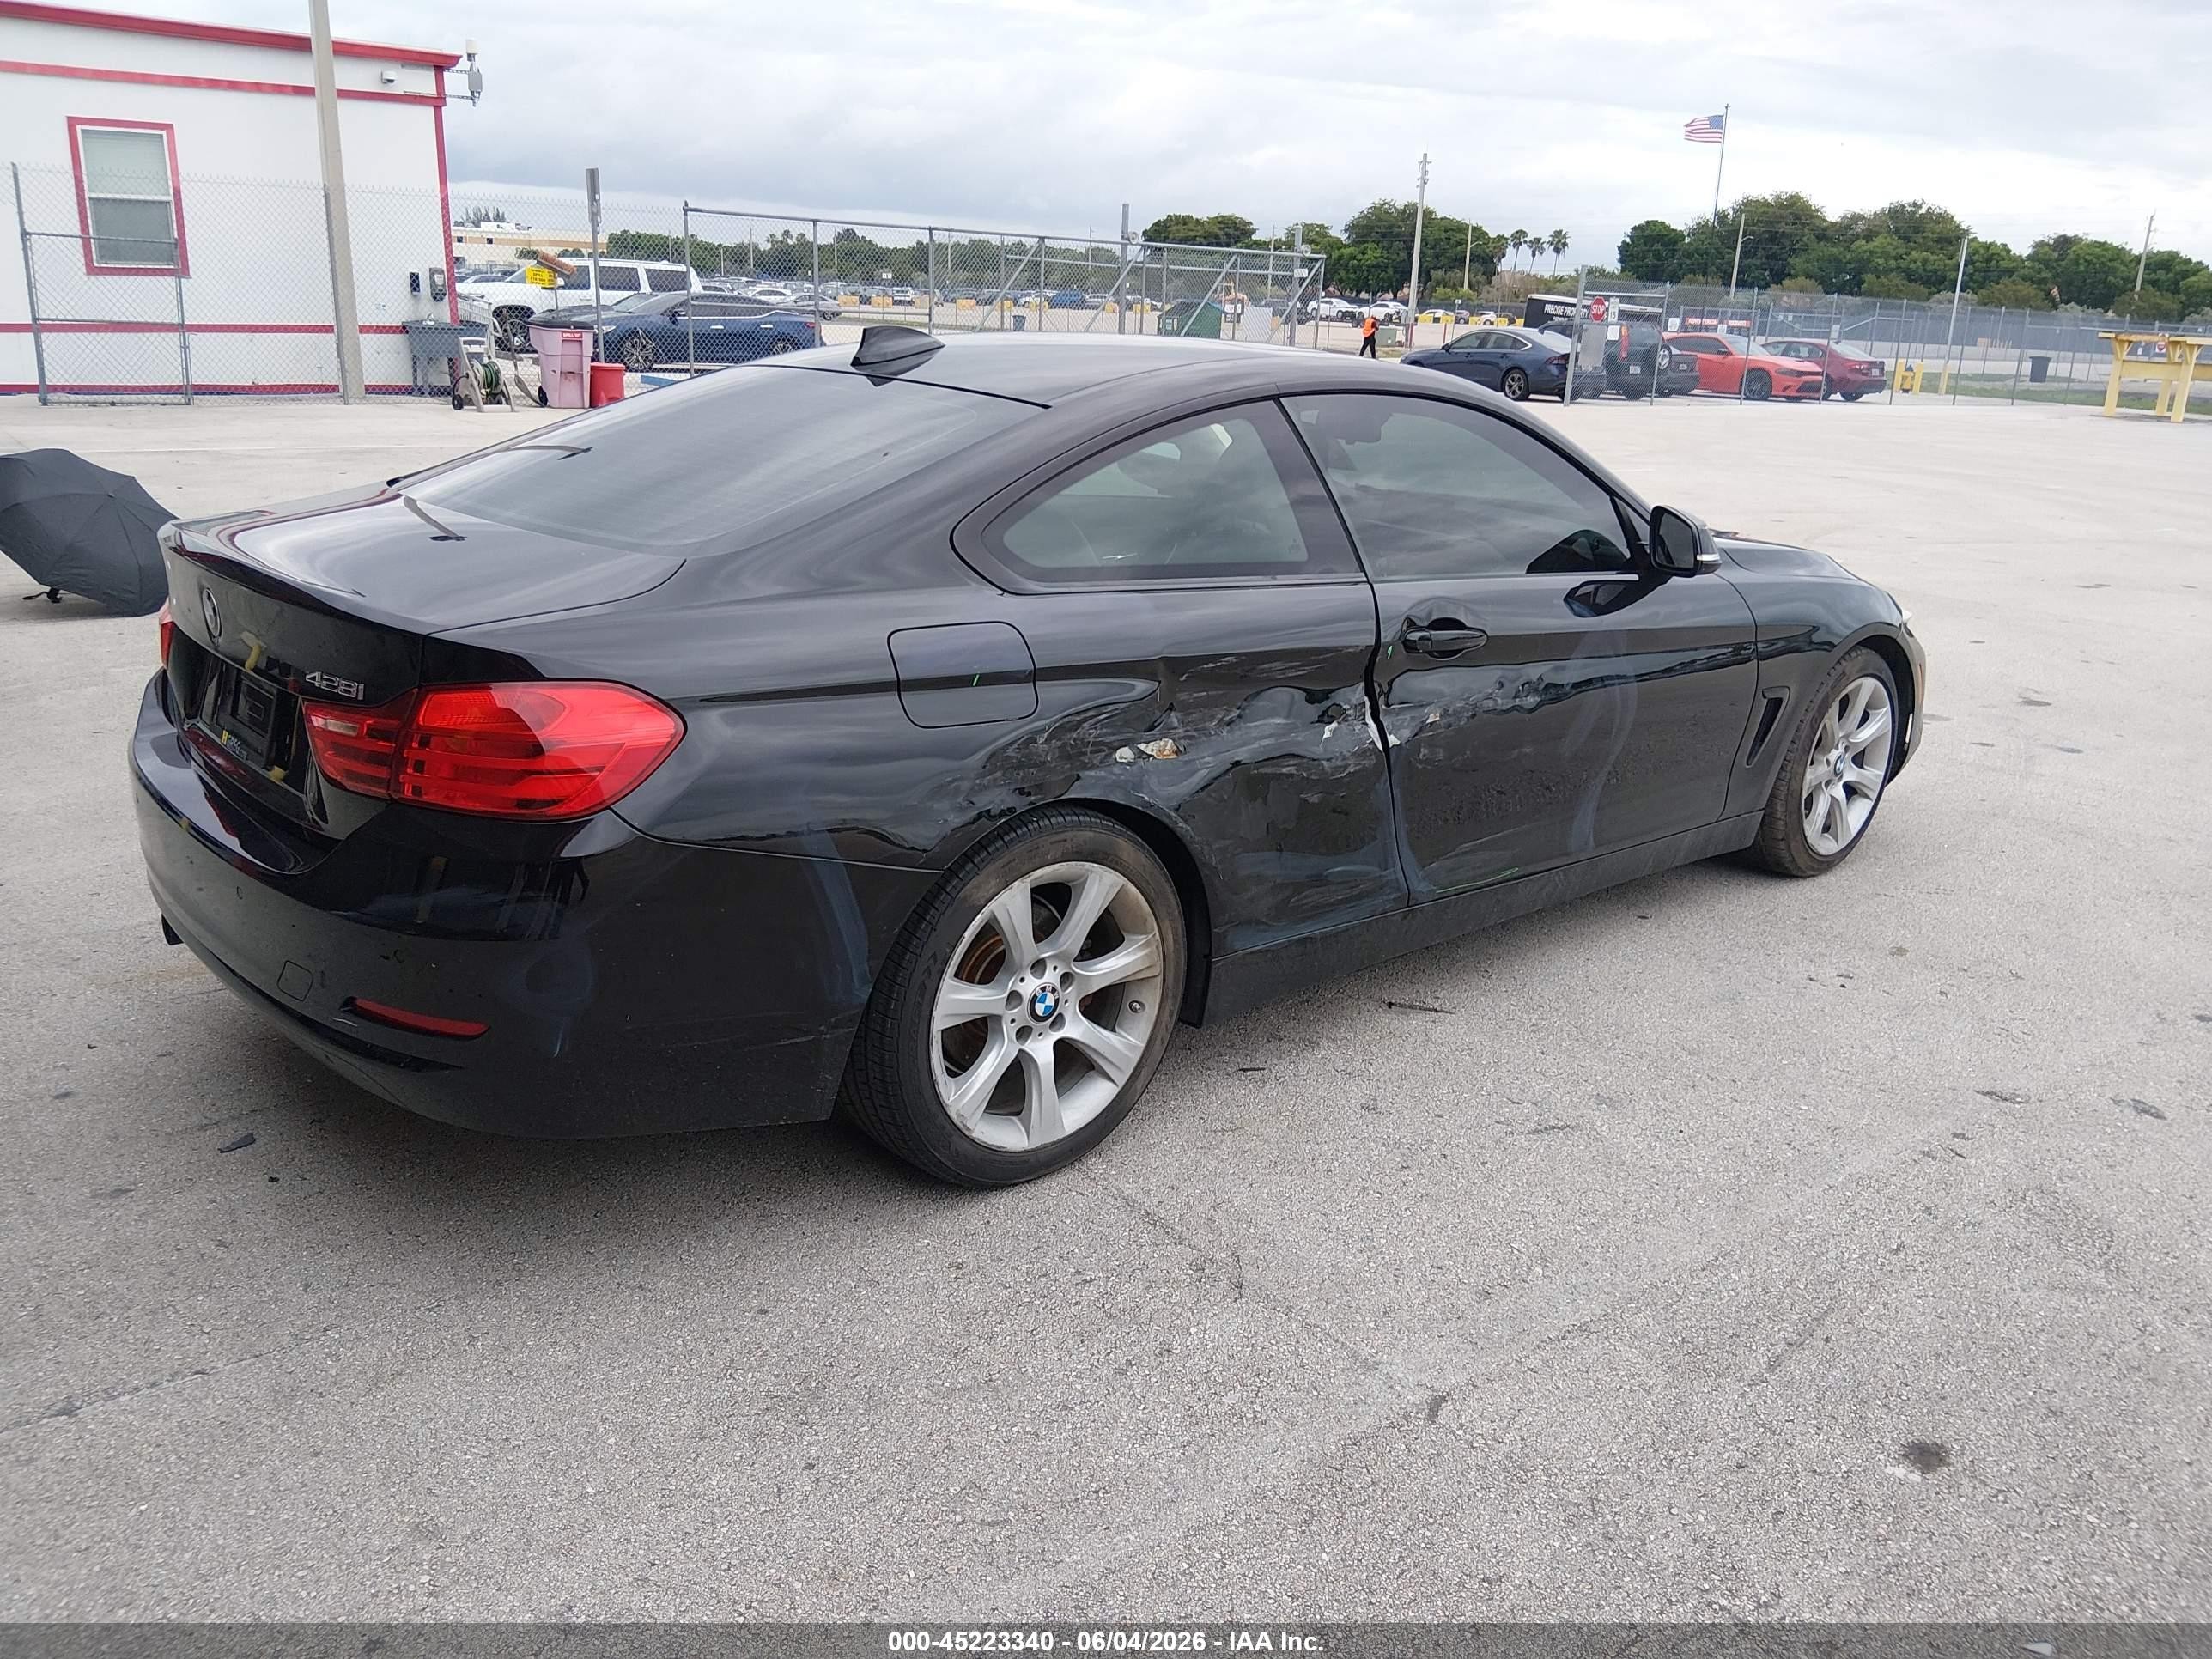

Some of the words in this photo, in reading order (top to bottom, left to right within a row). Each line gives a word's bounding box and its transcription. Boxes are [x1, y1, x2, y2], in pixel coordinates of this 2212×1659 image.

[1544, 303, 1565, 316] PRECISE
[1564, 306, 1589, 319] PRORTY
[1591, 305, 1605, 315] STOP
[1610, 311, 1616, 319] 15
[1034, 984, 1060, 1000] BMW
